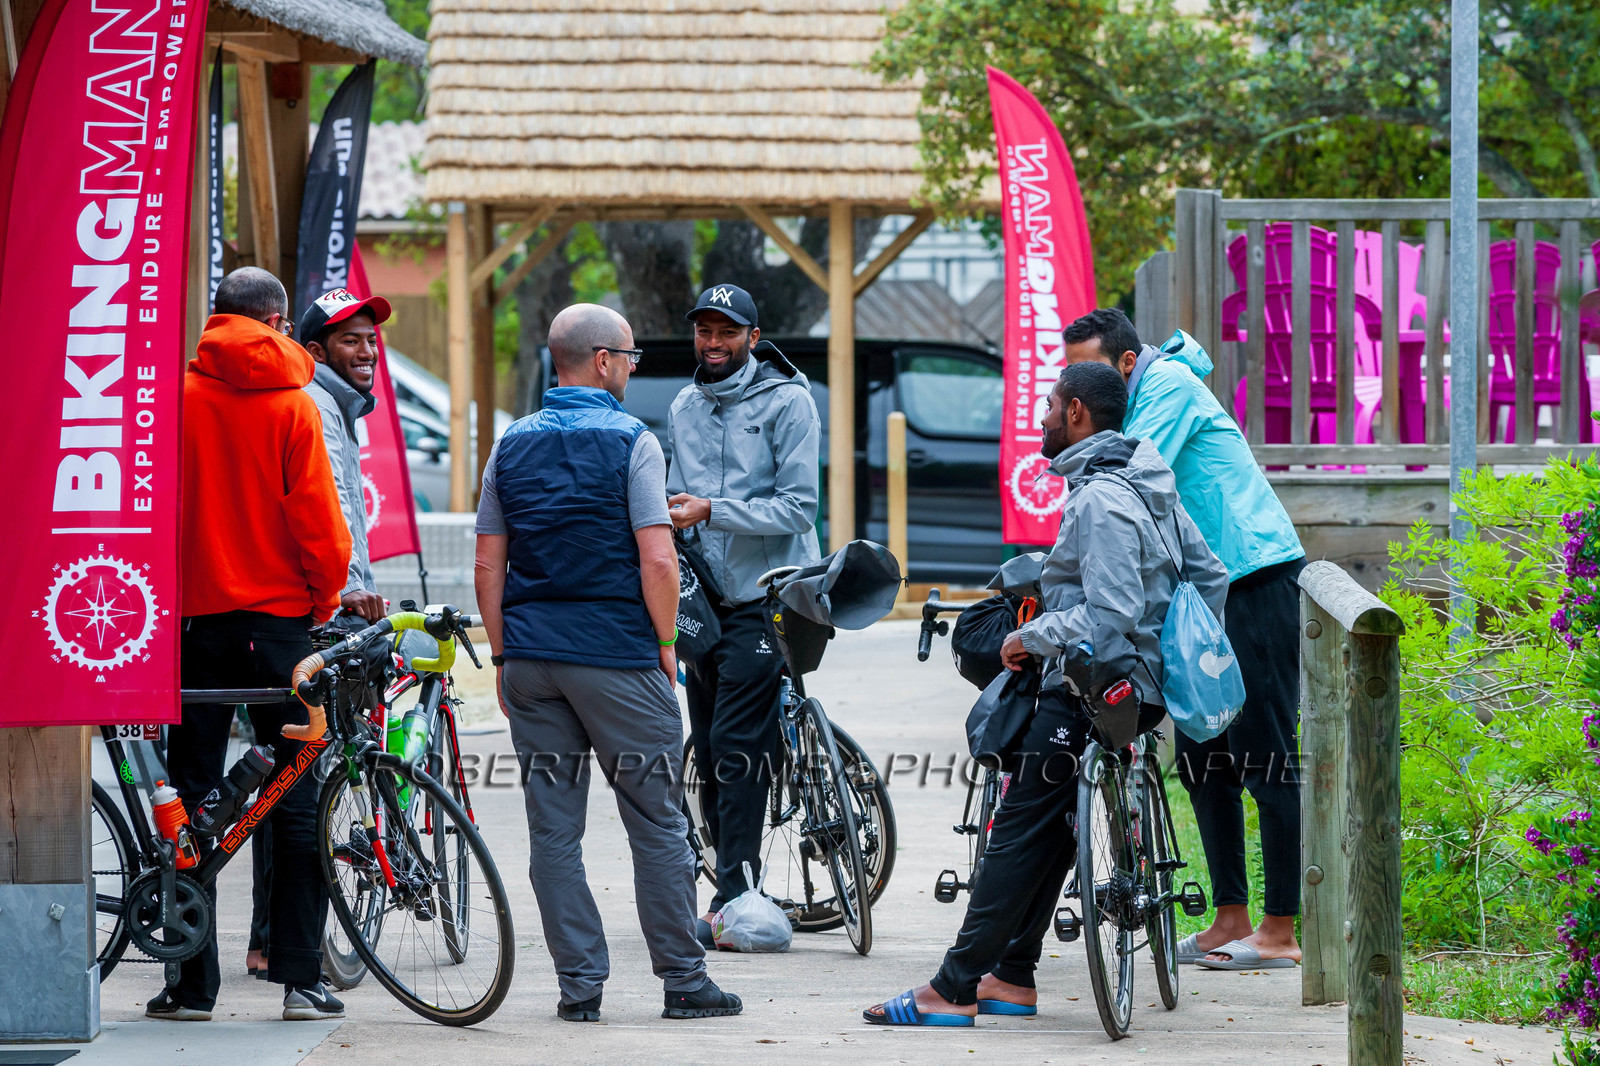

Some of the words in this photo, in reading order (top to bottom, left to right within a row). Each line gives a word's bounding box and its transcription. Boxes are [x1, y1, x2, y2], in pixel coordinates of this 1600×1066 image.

[52, 0, 160, 512] BIKINGMAN
[139, 193, 163, 322] ENDURE
[134, 366, 155, 511] EXPLORE
[98, 543, 105, 551] E
[31, 610, 39, 618] N
[95, 674, 106, 683] W
[118, 724, 141, 738] 38
[1049, 737, 1071, 746] KELME
[220, 738, 328, 854] BRESSAN
